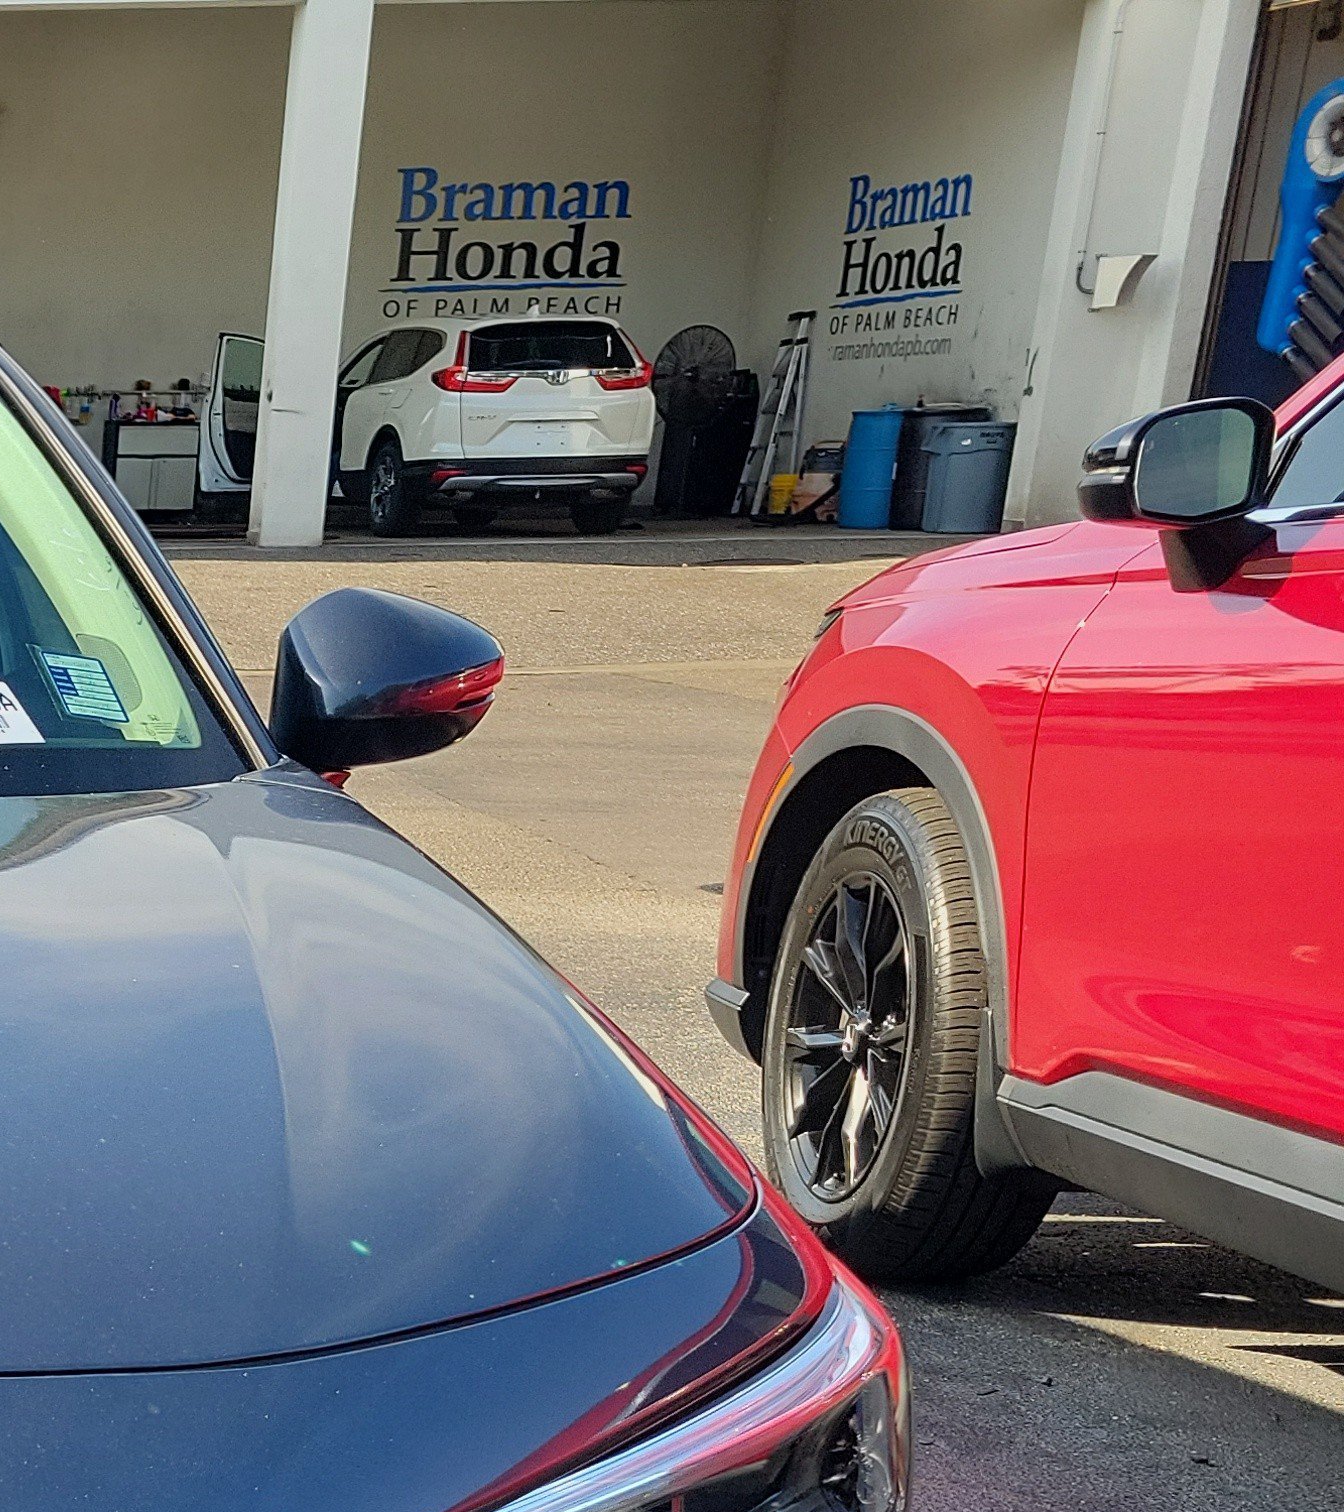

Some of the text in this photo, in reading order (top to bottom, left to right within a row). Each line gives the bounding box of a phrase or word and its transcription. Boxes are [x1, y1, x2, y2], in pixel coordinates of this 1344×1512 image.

[397, 167, 632, 222] Braman
[843, 173, 973, 234] Braman
[389, 222, 622, 282] Honda
[834, 224, 964, 299] Honda
[382, 300, 418, 318] OF
[829, 303, 959, 336] OF PALM BEACH
[829, 334, 952, 361] ramanhondapb.com
[843, 819, 905, 866] KINERGY
